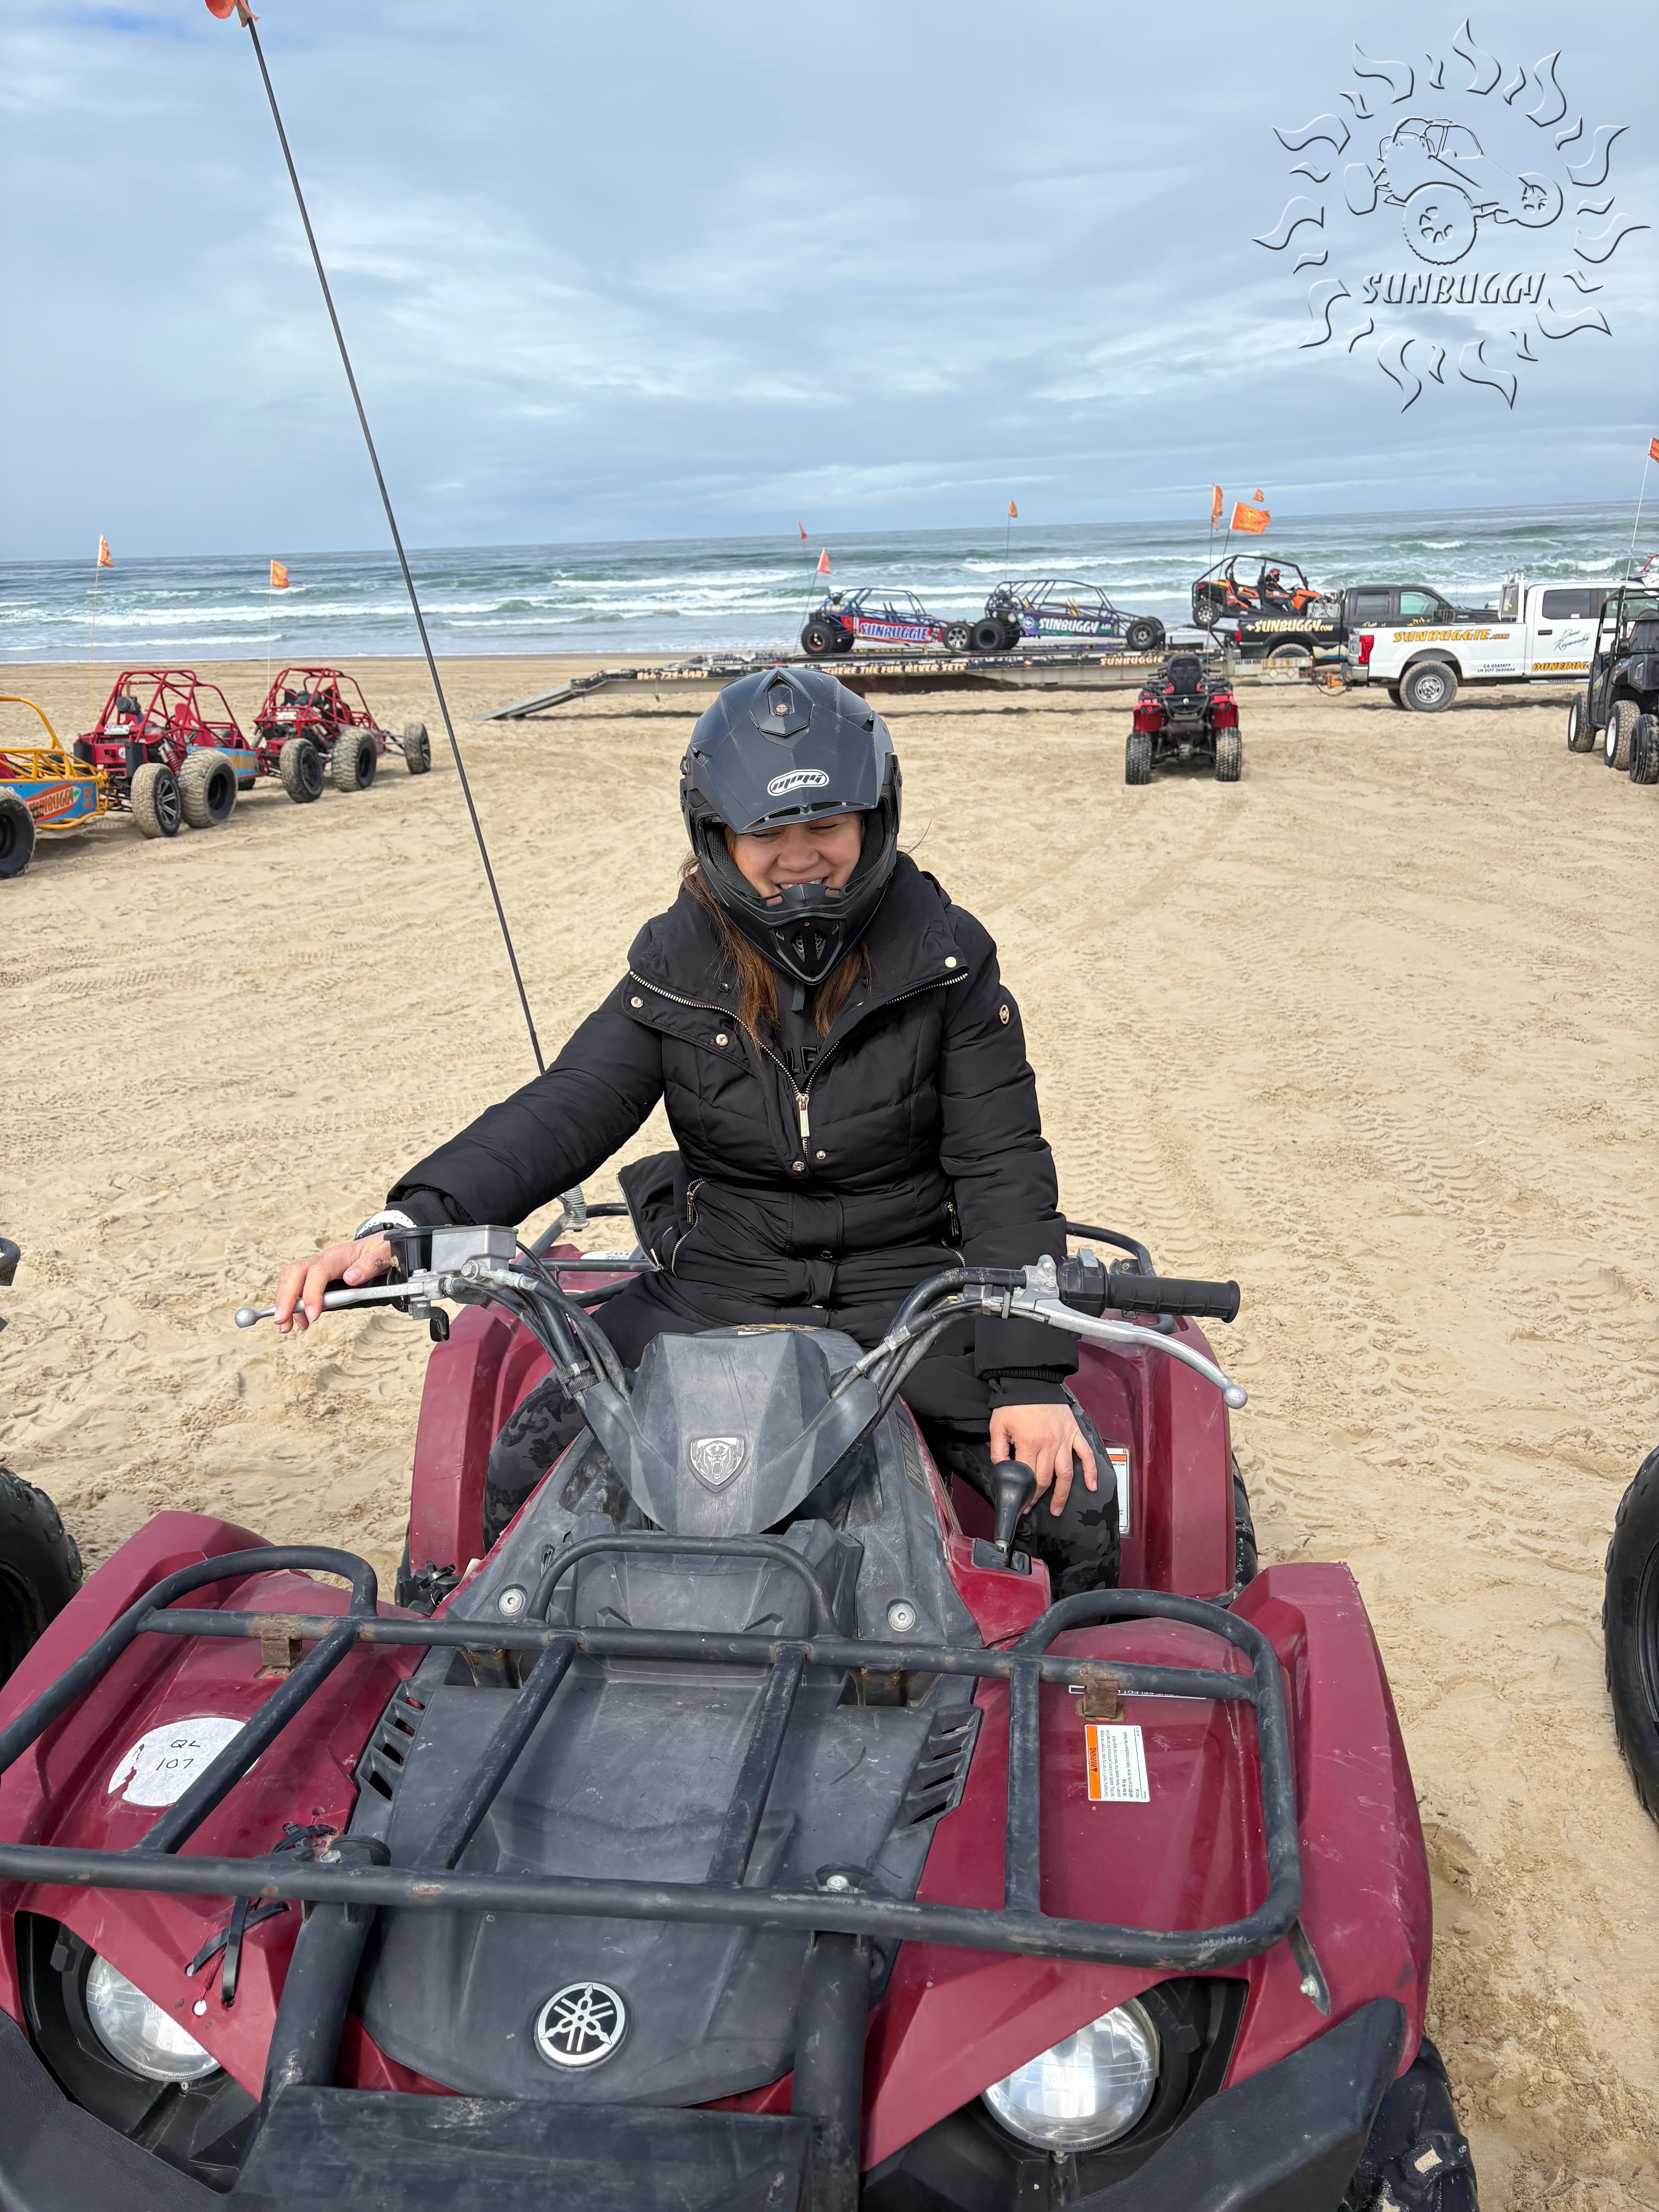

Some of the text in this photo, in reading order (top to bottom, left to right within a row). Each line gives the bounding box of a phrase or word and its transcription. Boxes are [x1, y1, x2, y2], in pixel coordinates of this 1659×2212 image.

[1039, 617, 1100, 632] SUNBUGGY
[859, 623, 928, 640] SUNBUGGIE
[1100, 655, 1165, 666] SUNBUGGIE
[860, 665, 880, 674] THE
[881, 665, 903, 673] FUN
[905, 664, 939, 673] NEVER
[941, 662, 966, 671] SETS
[156, 1758, 194, 1770] 107
